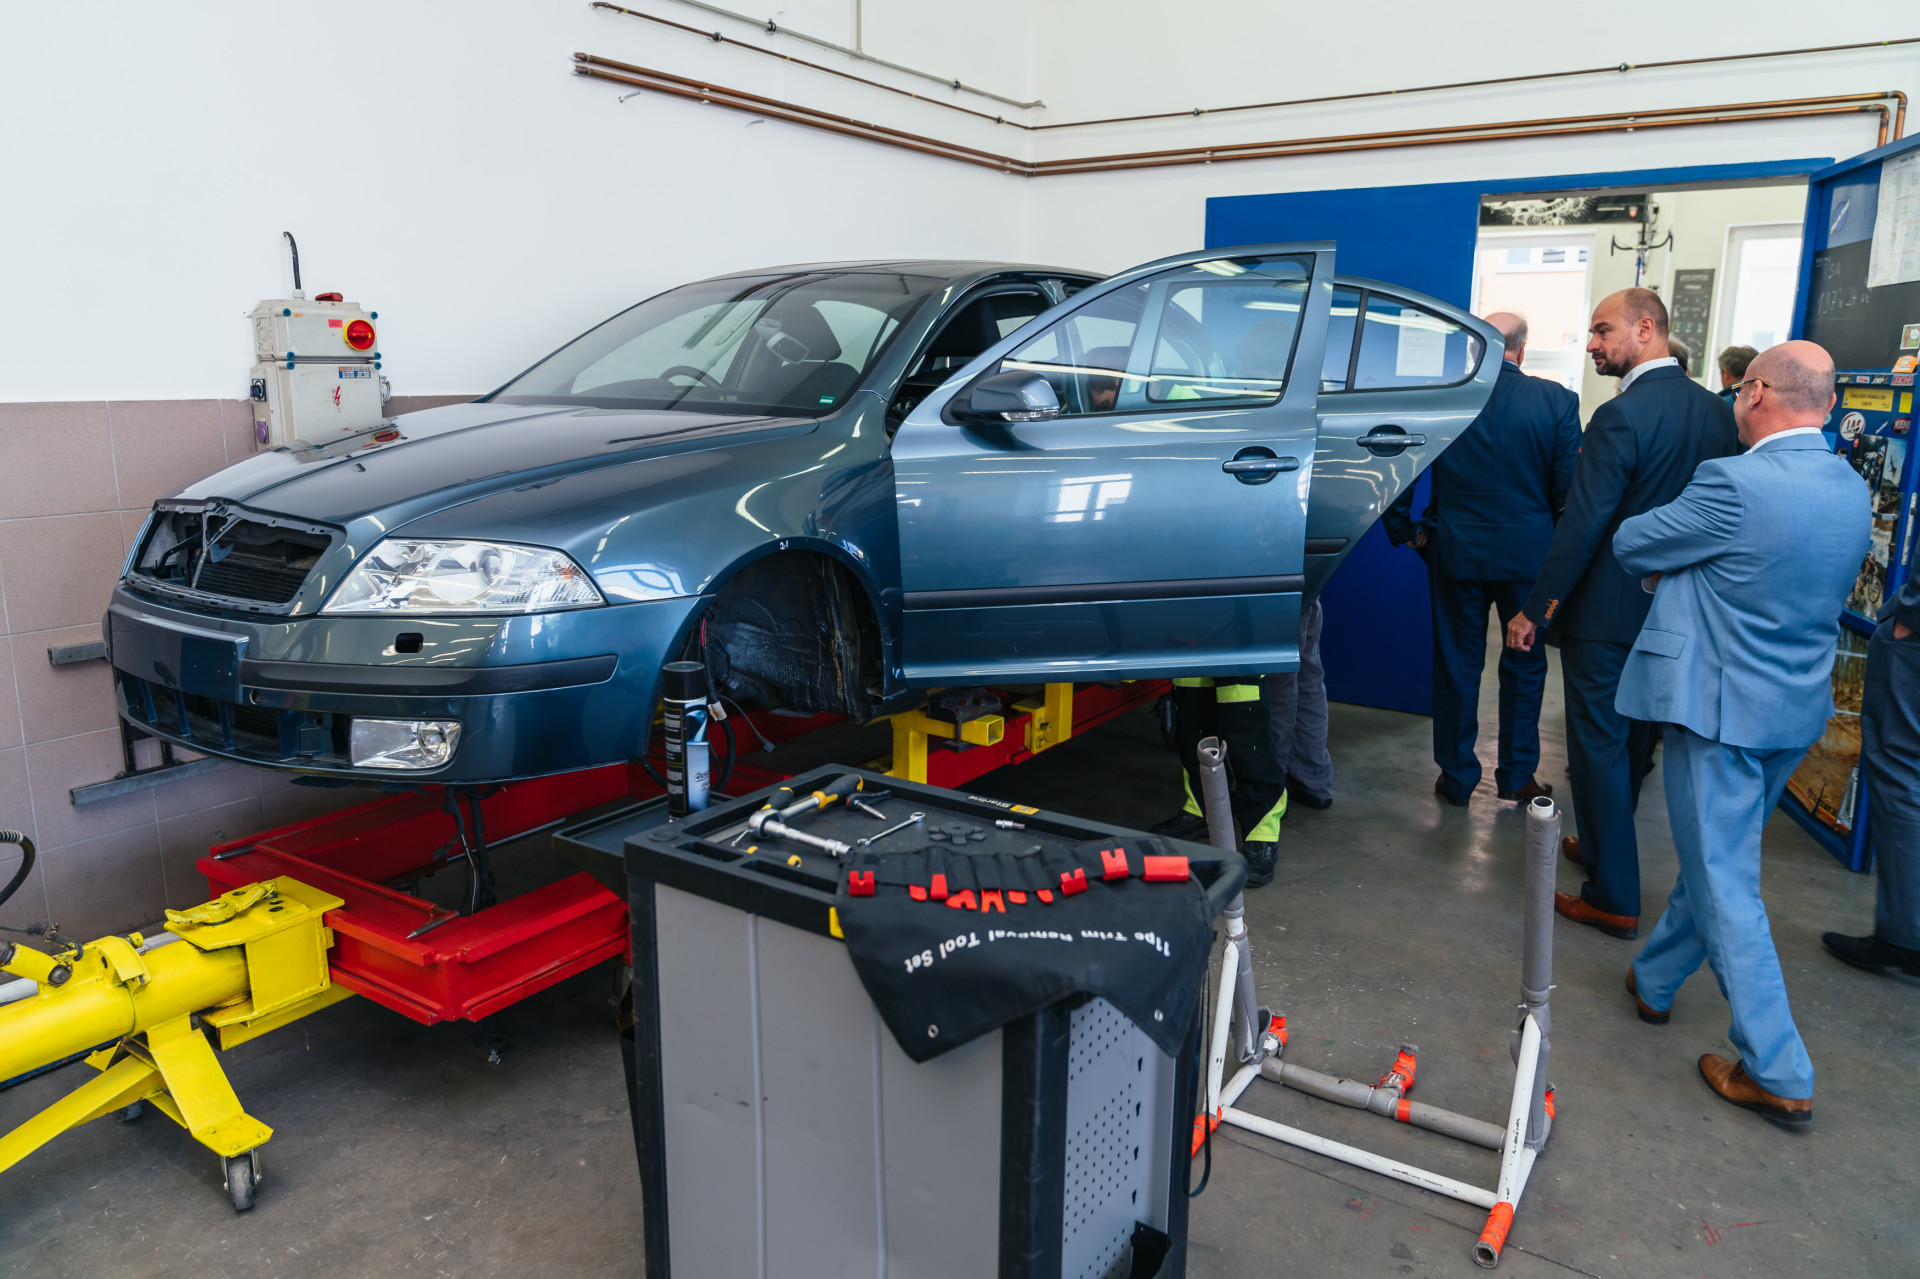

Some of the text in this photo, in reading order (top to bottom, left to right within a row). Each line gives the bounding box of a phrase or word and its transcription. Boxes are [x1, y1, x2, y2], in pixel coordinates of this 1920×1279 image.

[1891, 375, 1913, 385] KENDA
[968, 795, 1012, 808] Starline
[988, 929, 1074, 943] Removal
[1081, 930, 1128, 942] Trim
[939, 932, 981, 960] Tool
[904, 949, 934, 974] Set
